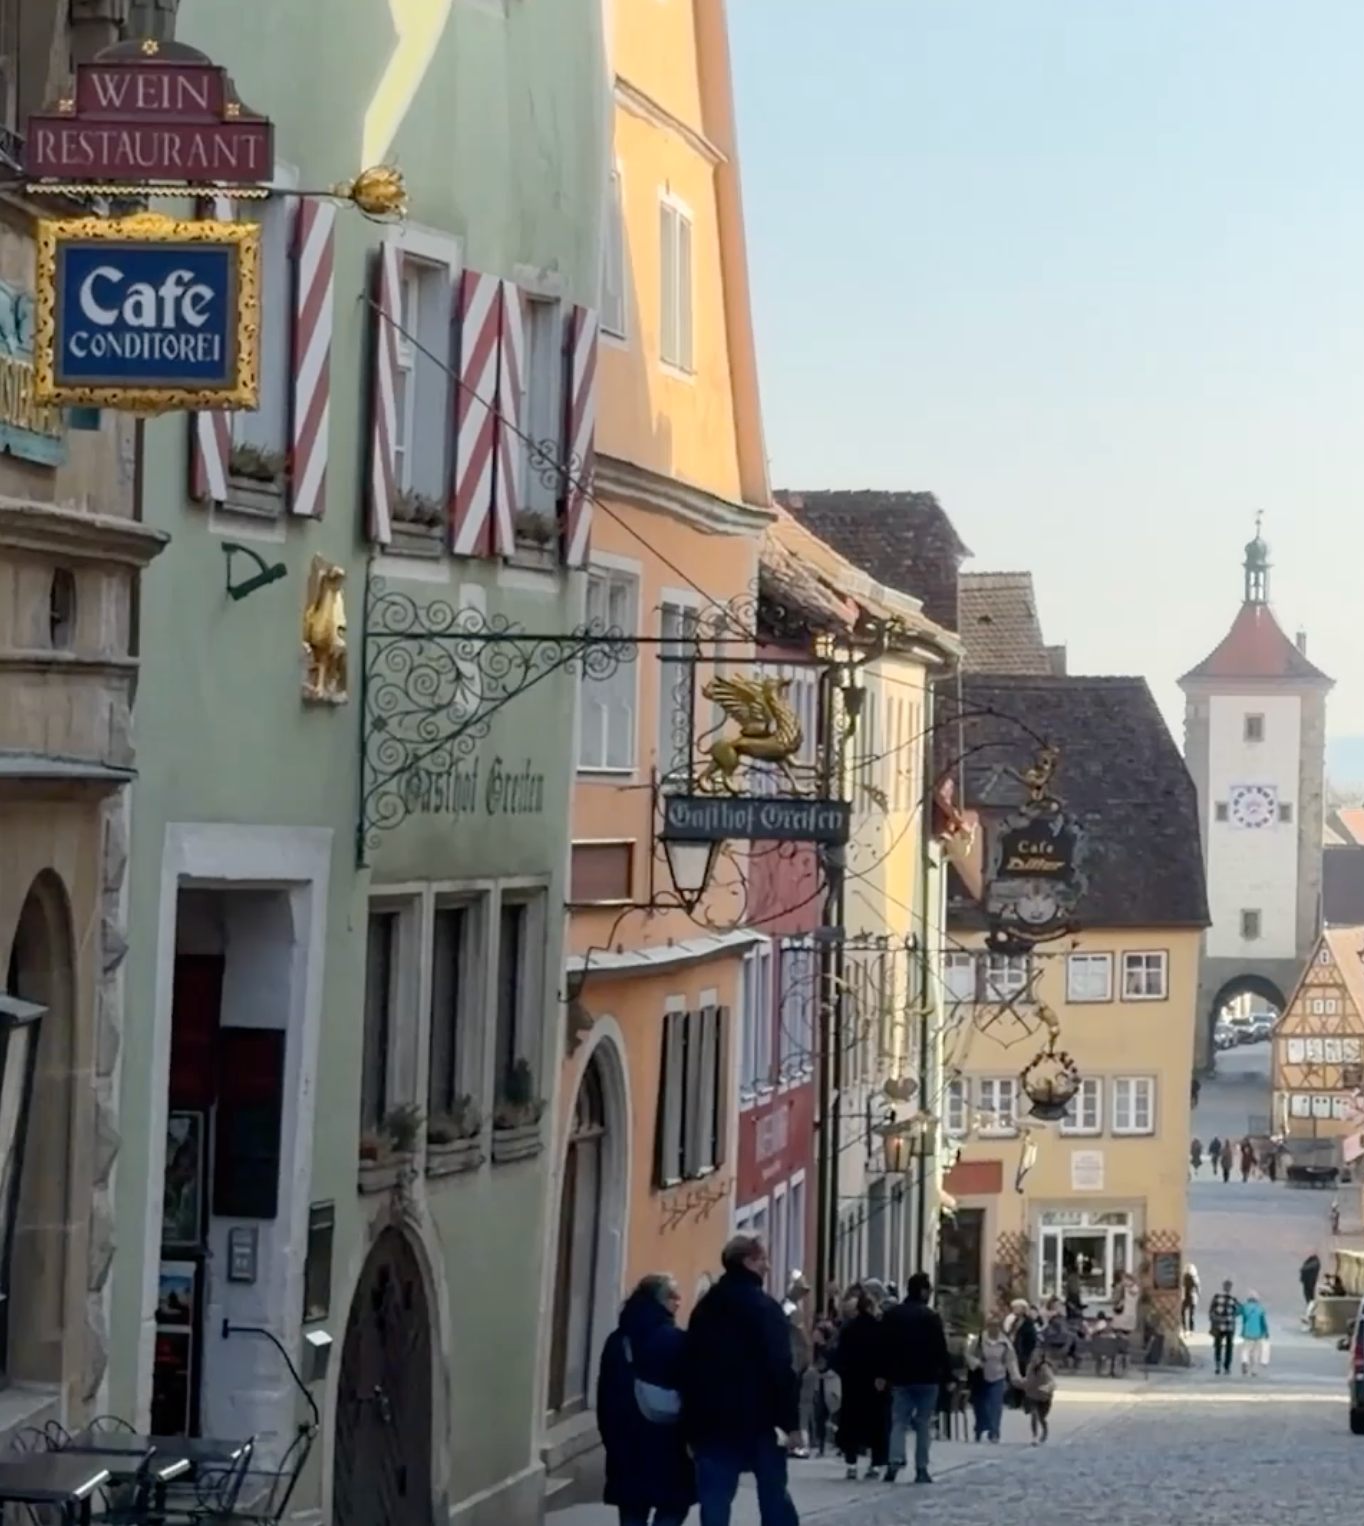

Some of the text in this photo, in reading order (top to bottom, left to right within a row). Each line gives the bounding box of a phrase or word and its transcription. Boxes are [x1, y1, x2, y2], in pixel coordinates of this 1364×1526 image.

[91, 73, 209, 109] WEIN
[36, 129, 264, 169] RESTAURANT
[79, 265, 216, 328] Cafe
[69, 331, 221, 362] CONDITOREI
[669, 802, 758, 834] Gasthof
[1018, 840, 1055, 853] Cafe
